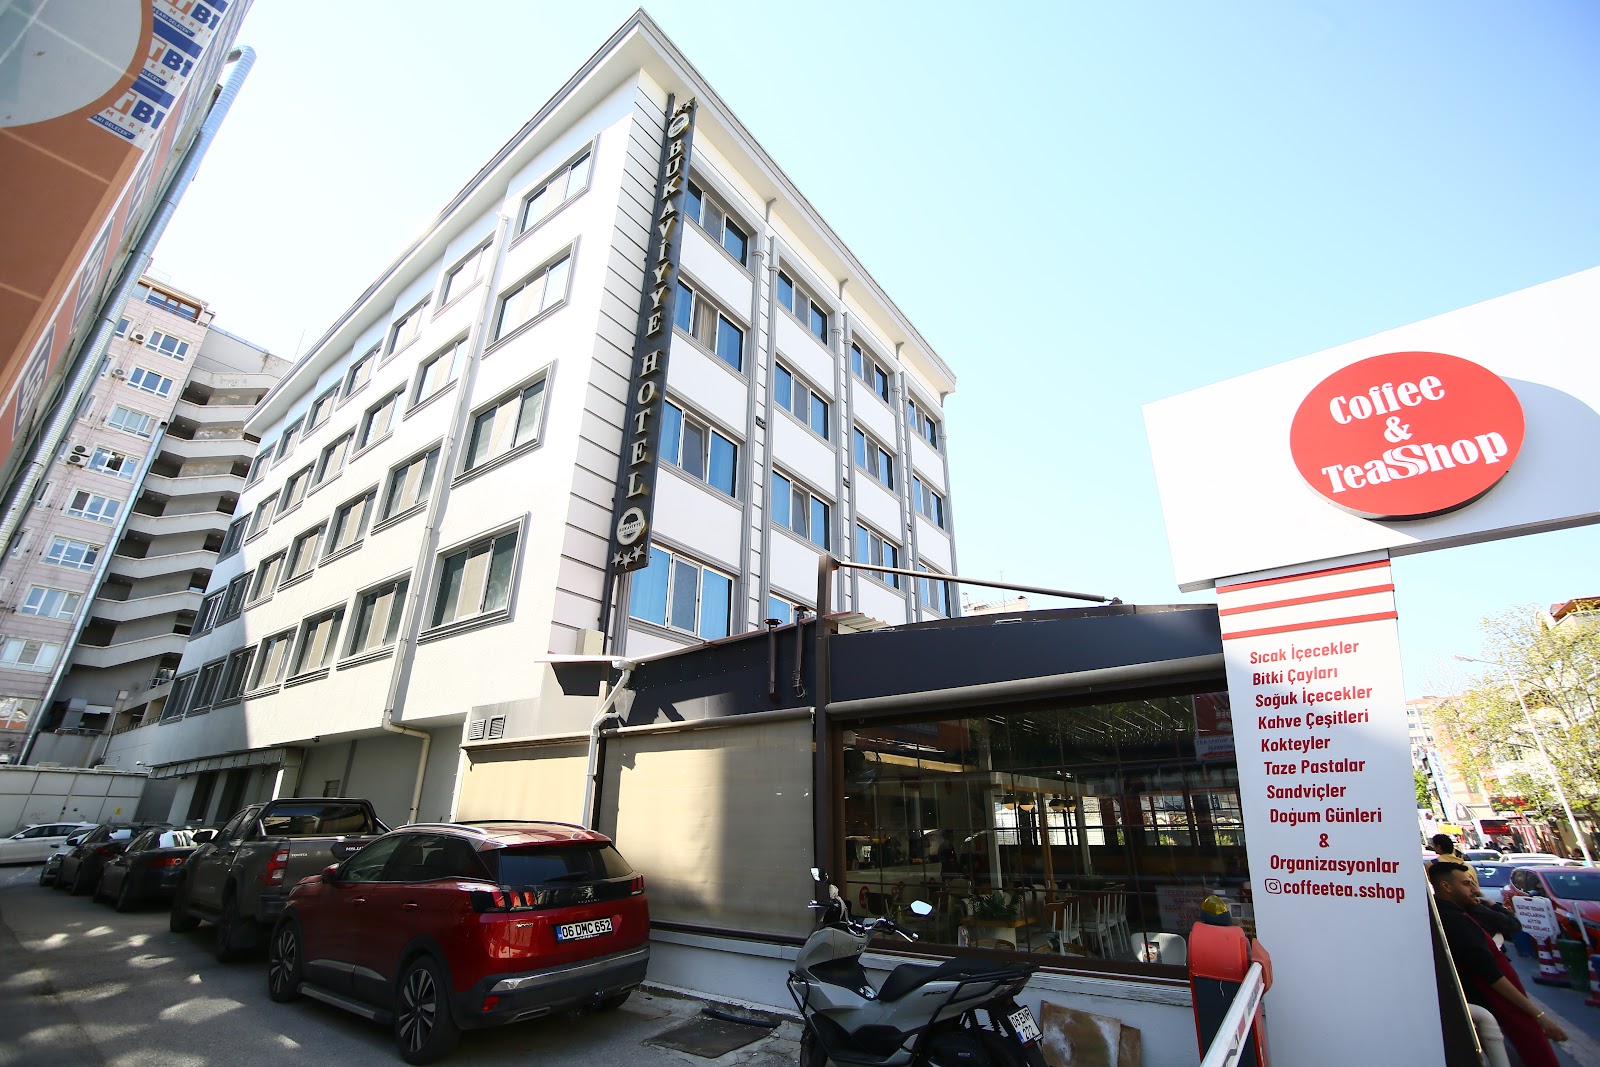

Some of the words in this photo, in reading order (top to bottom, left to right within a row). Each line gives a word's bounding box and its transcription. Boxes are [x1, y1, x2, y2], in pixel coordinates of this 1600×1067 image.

[645, 138, 683, 339] BUKAVİYYE
[18, 335, 50, 428] LGS
[1329, 375, 1446, 425] Coffee
[626, 349, 660, 499] HOTEL
[1383, 415, 1413, 443] &
[1250, 650, 1287, 664] Sıcak
[1291, 641, 1360, 663] İçecekler
[1253, 670, 1284, 686] Bitki
[1287, 667, 1338, 685] Çayları
[1255, 691, 1298, 710] Soğuk
[1302, 685, 1373, 704] İçecekler
[1258, 714, 1302, 730] Kahve
[1305, 708, 1369, 729] Çeşitleri
[1261, 736, 1330, 753] Kokteyler
[1264, 760, 1297, 776] Taze
[1301, 758, 1366, 775] Pastalar
[1266, 783, 1347, 801] Sandviçler
[1325, 807, 1382, 823] Günleri
[1318, 832, 1330, 848] &
[1270, 855, 1400, 875] Organizasyonlar
[1283, 880, 1406, 903] coffeetea.sshop
[562, 926, 575, 938] 06
[575, 923, 594, 936] DMC
[594, 920, 612, 933] 652
